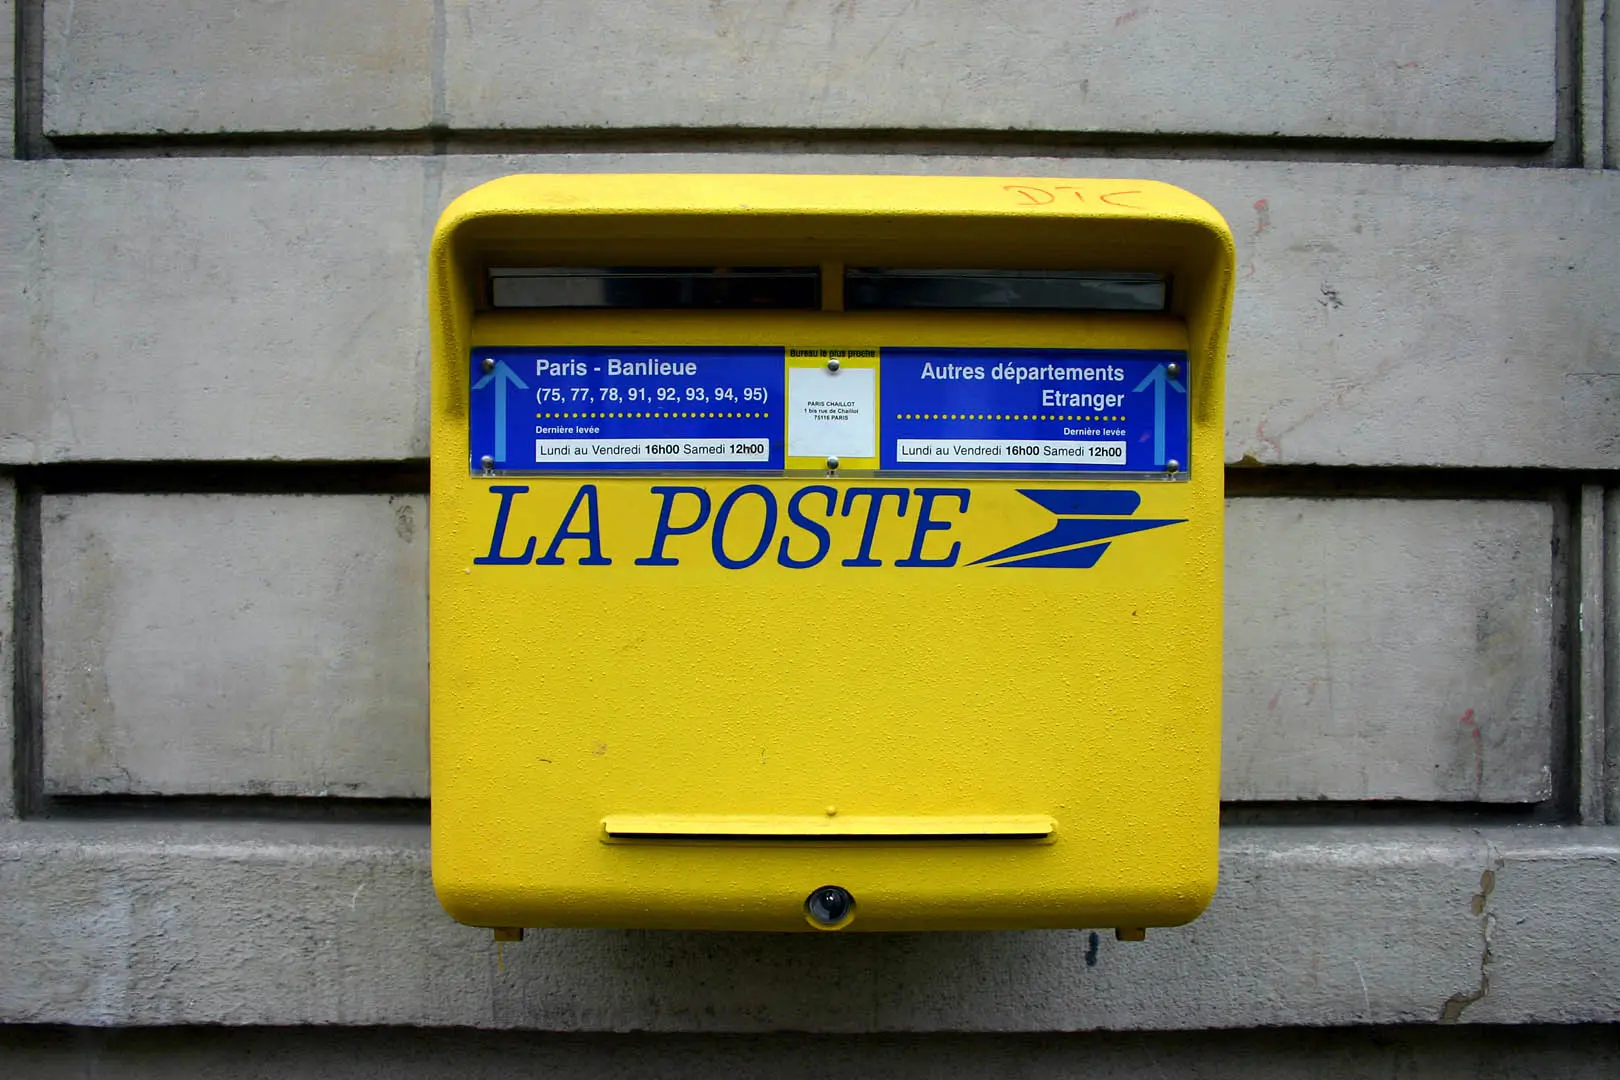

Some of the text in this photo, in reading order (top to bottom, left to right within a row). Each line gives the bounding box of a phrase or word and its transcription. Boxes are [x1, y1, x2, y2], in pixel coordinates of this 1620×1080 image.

[790, 349, 876, 359] Bureau le plus proche
[536, 359, 587, 376] Paris
[607, 359, 697, 376] Banlieue
[921, 361, 1125, 384] Autres départements
[536, 387, 768, 404] (75, 77, 78, 91, 92, 93, 94, 95)
[1042, 389, 1125, 411] Etranger
[536, 425, 600, 434] Dernière levée
[1063, 427, 1126, 436] Dernière levée
[540, 443, 764, 455] Lundi au Vendredi 16h00 Samedi 12h00
[902, 444, 1122, 457] Lundi au Vendredi 16h00 Samedi 12h00
[473, 484, 971, 569] LA POSTE
